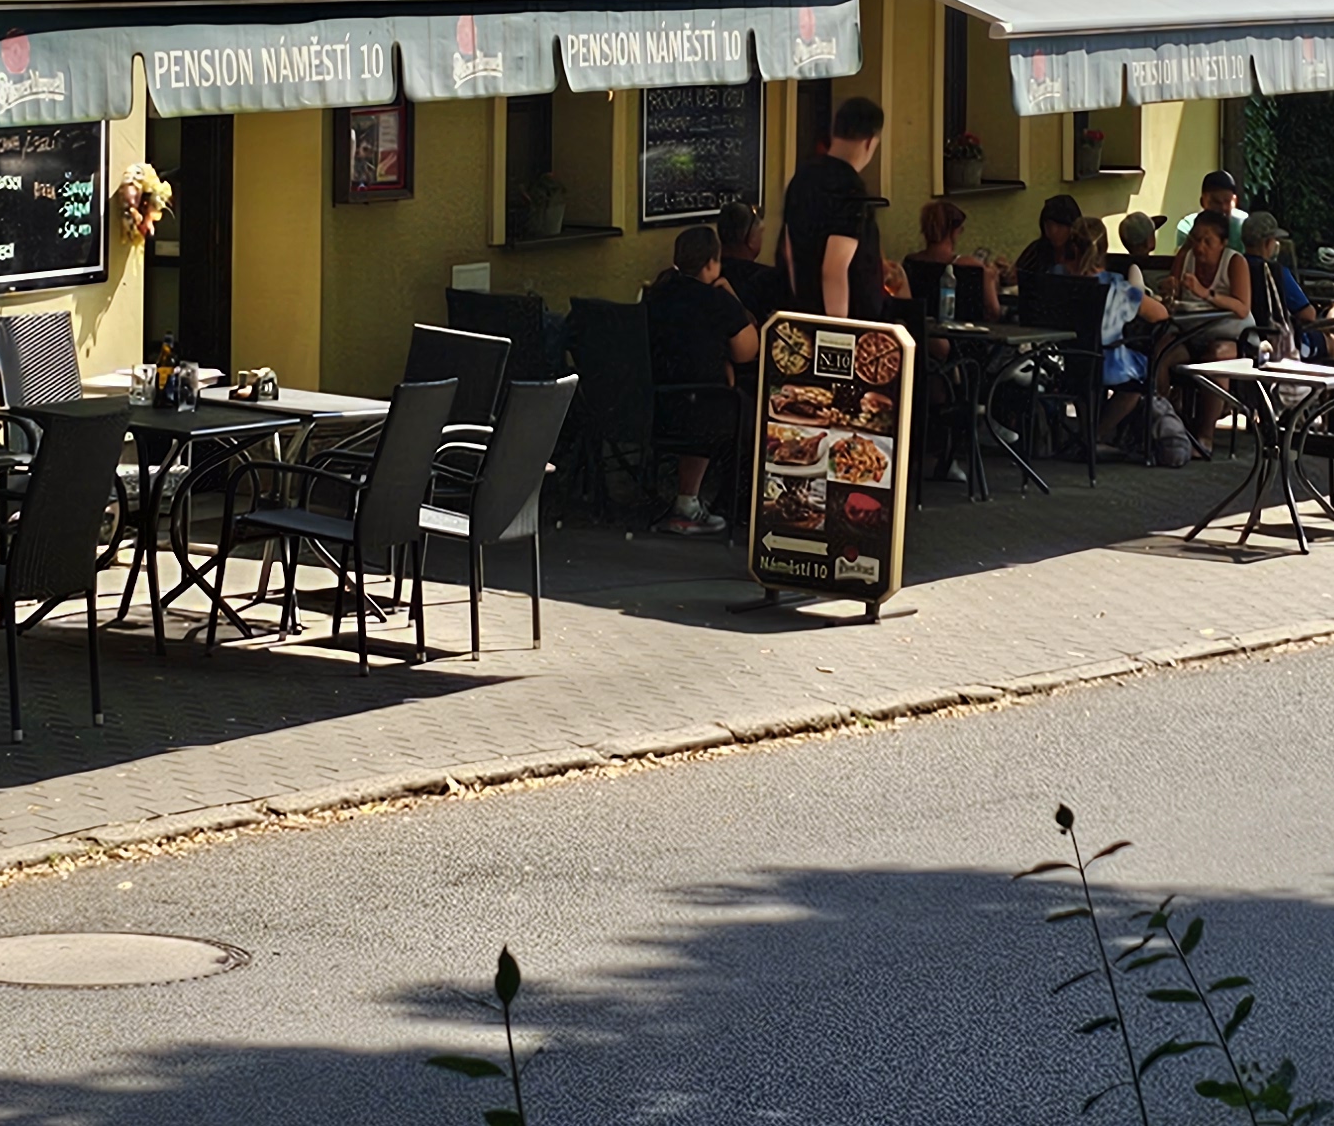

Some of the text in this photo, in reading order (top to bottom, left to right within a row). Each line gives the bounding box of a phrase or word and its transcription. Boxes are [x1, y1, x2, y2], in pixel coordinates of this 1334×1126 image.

[154, 32, 385, 90] PENSION NÁMĚSTÍ 10
[567, 20, 742, 68] PENSION NÁMĚSTÍ 10
[1230, 54, 1244, 80] 10
